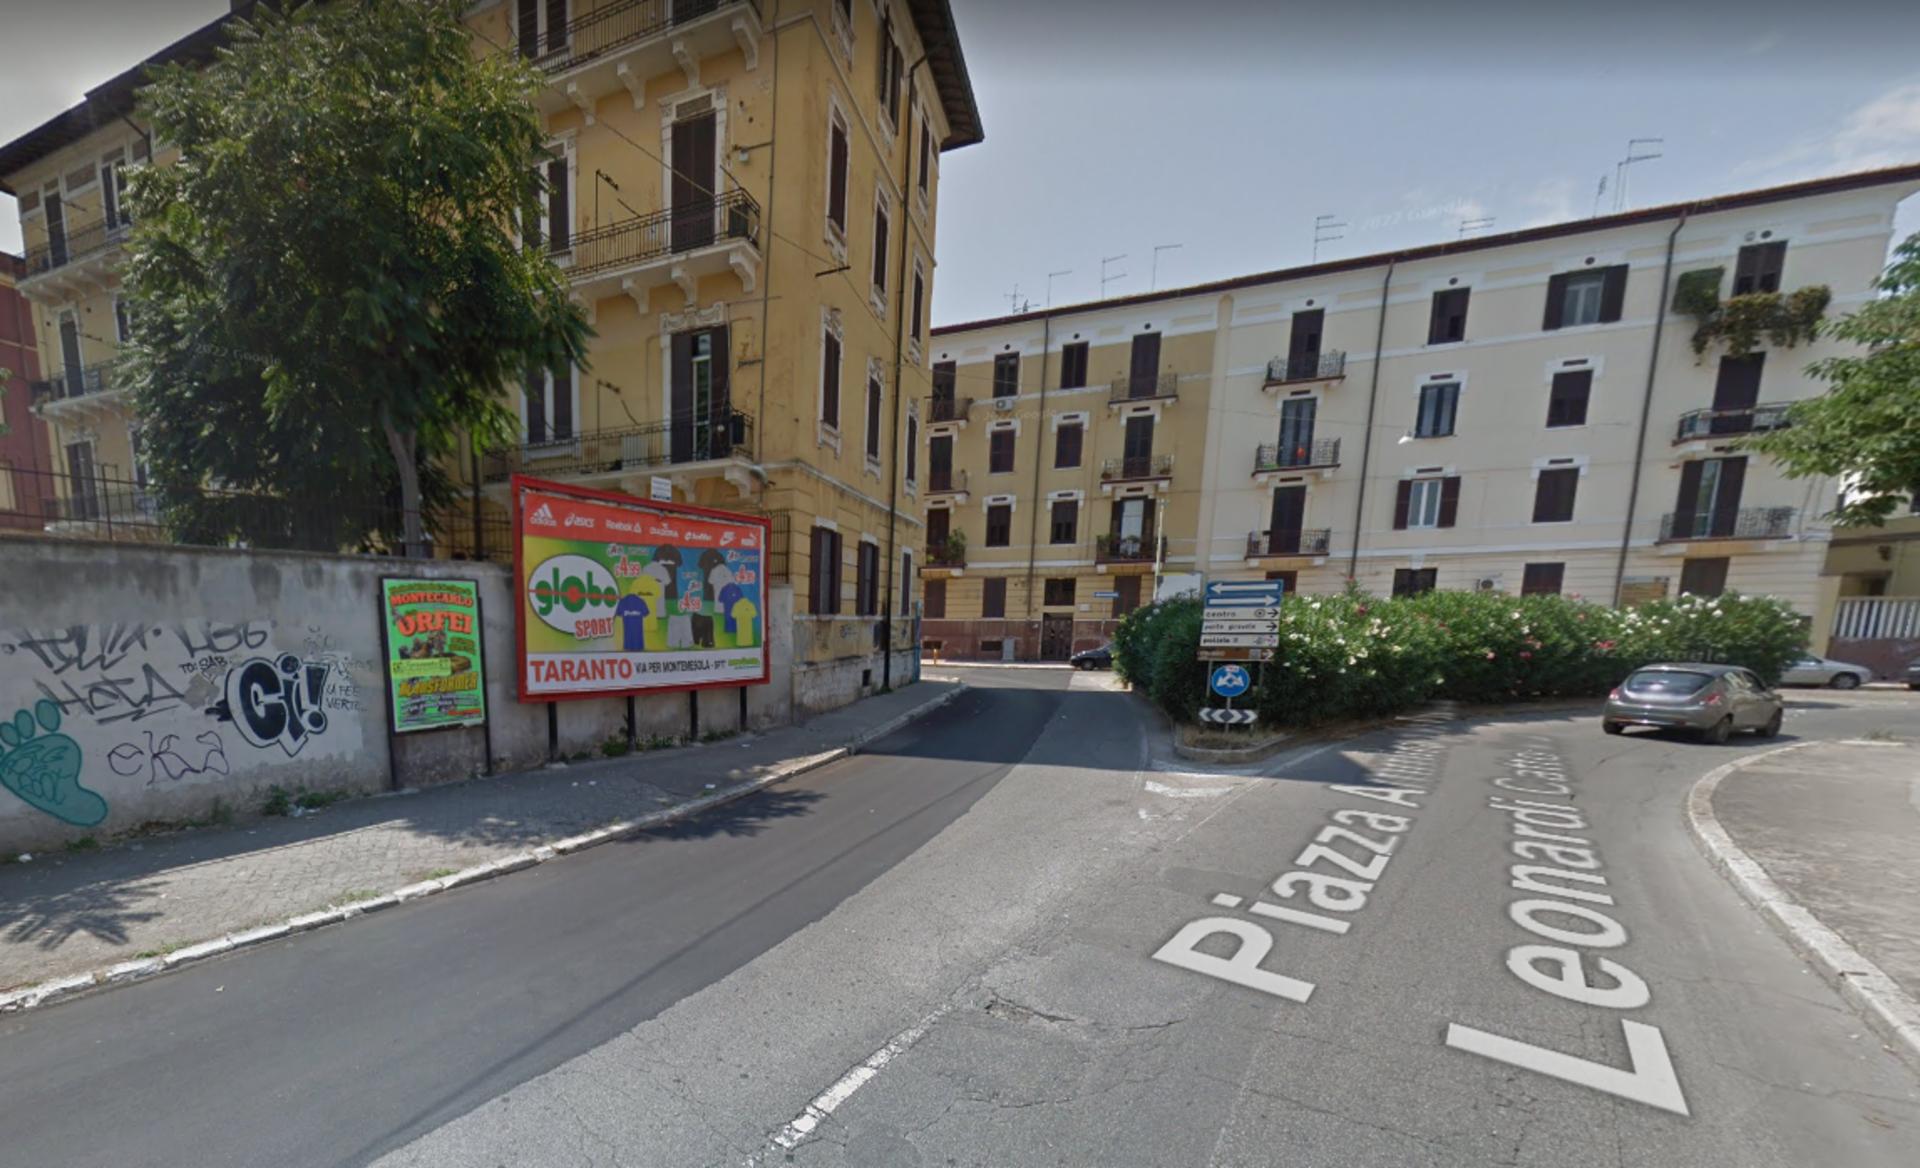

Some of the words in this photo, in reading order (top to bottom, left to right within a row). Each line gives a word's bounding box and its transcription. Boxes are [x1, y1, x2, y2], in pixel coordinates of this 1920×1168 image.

[389, 591, 474, 608] MONTECARLO
[535, 567, 618, 616] globo
[397, 611, 474, 637] ORFEI
[574, 616, 614, 640] SPORT
[530, 658, 633, 683] TARANTO
[648, 661, 662, 674] PER
